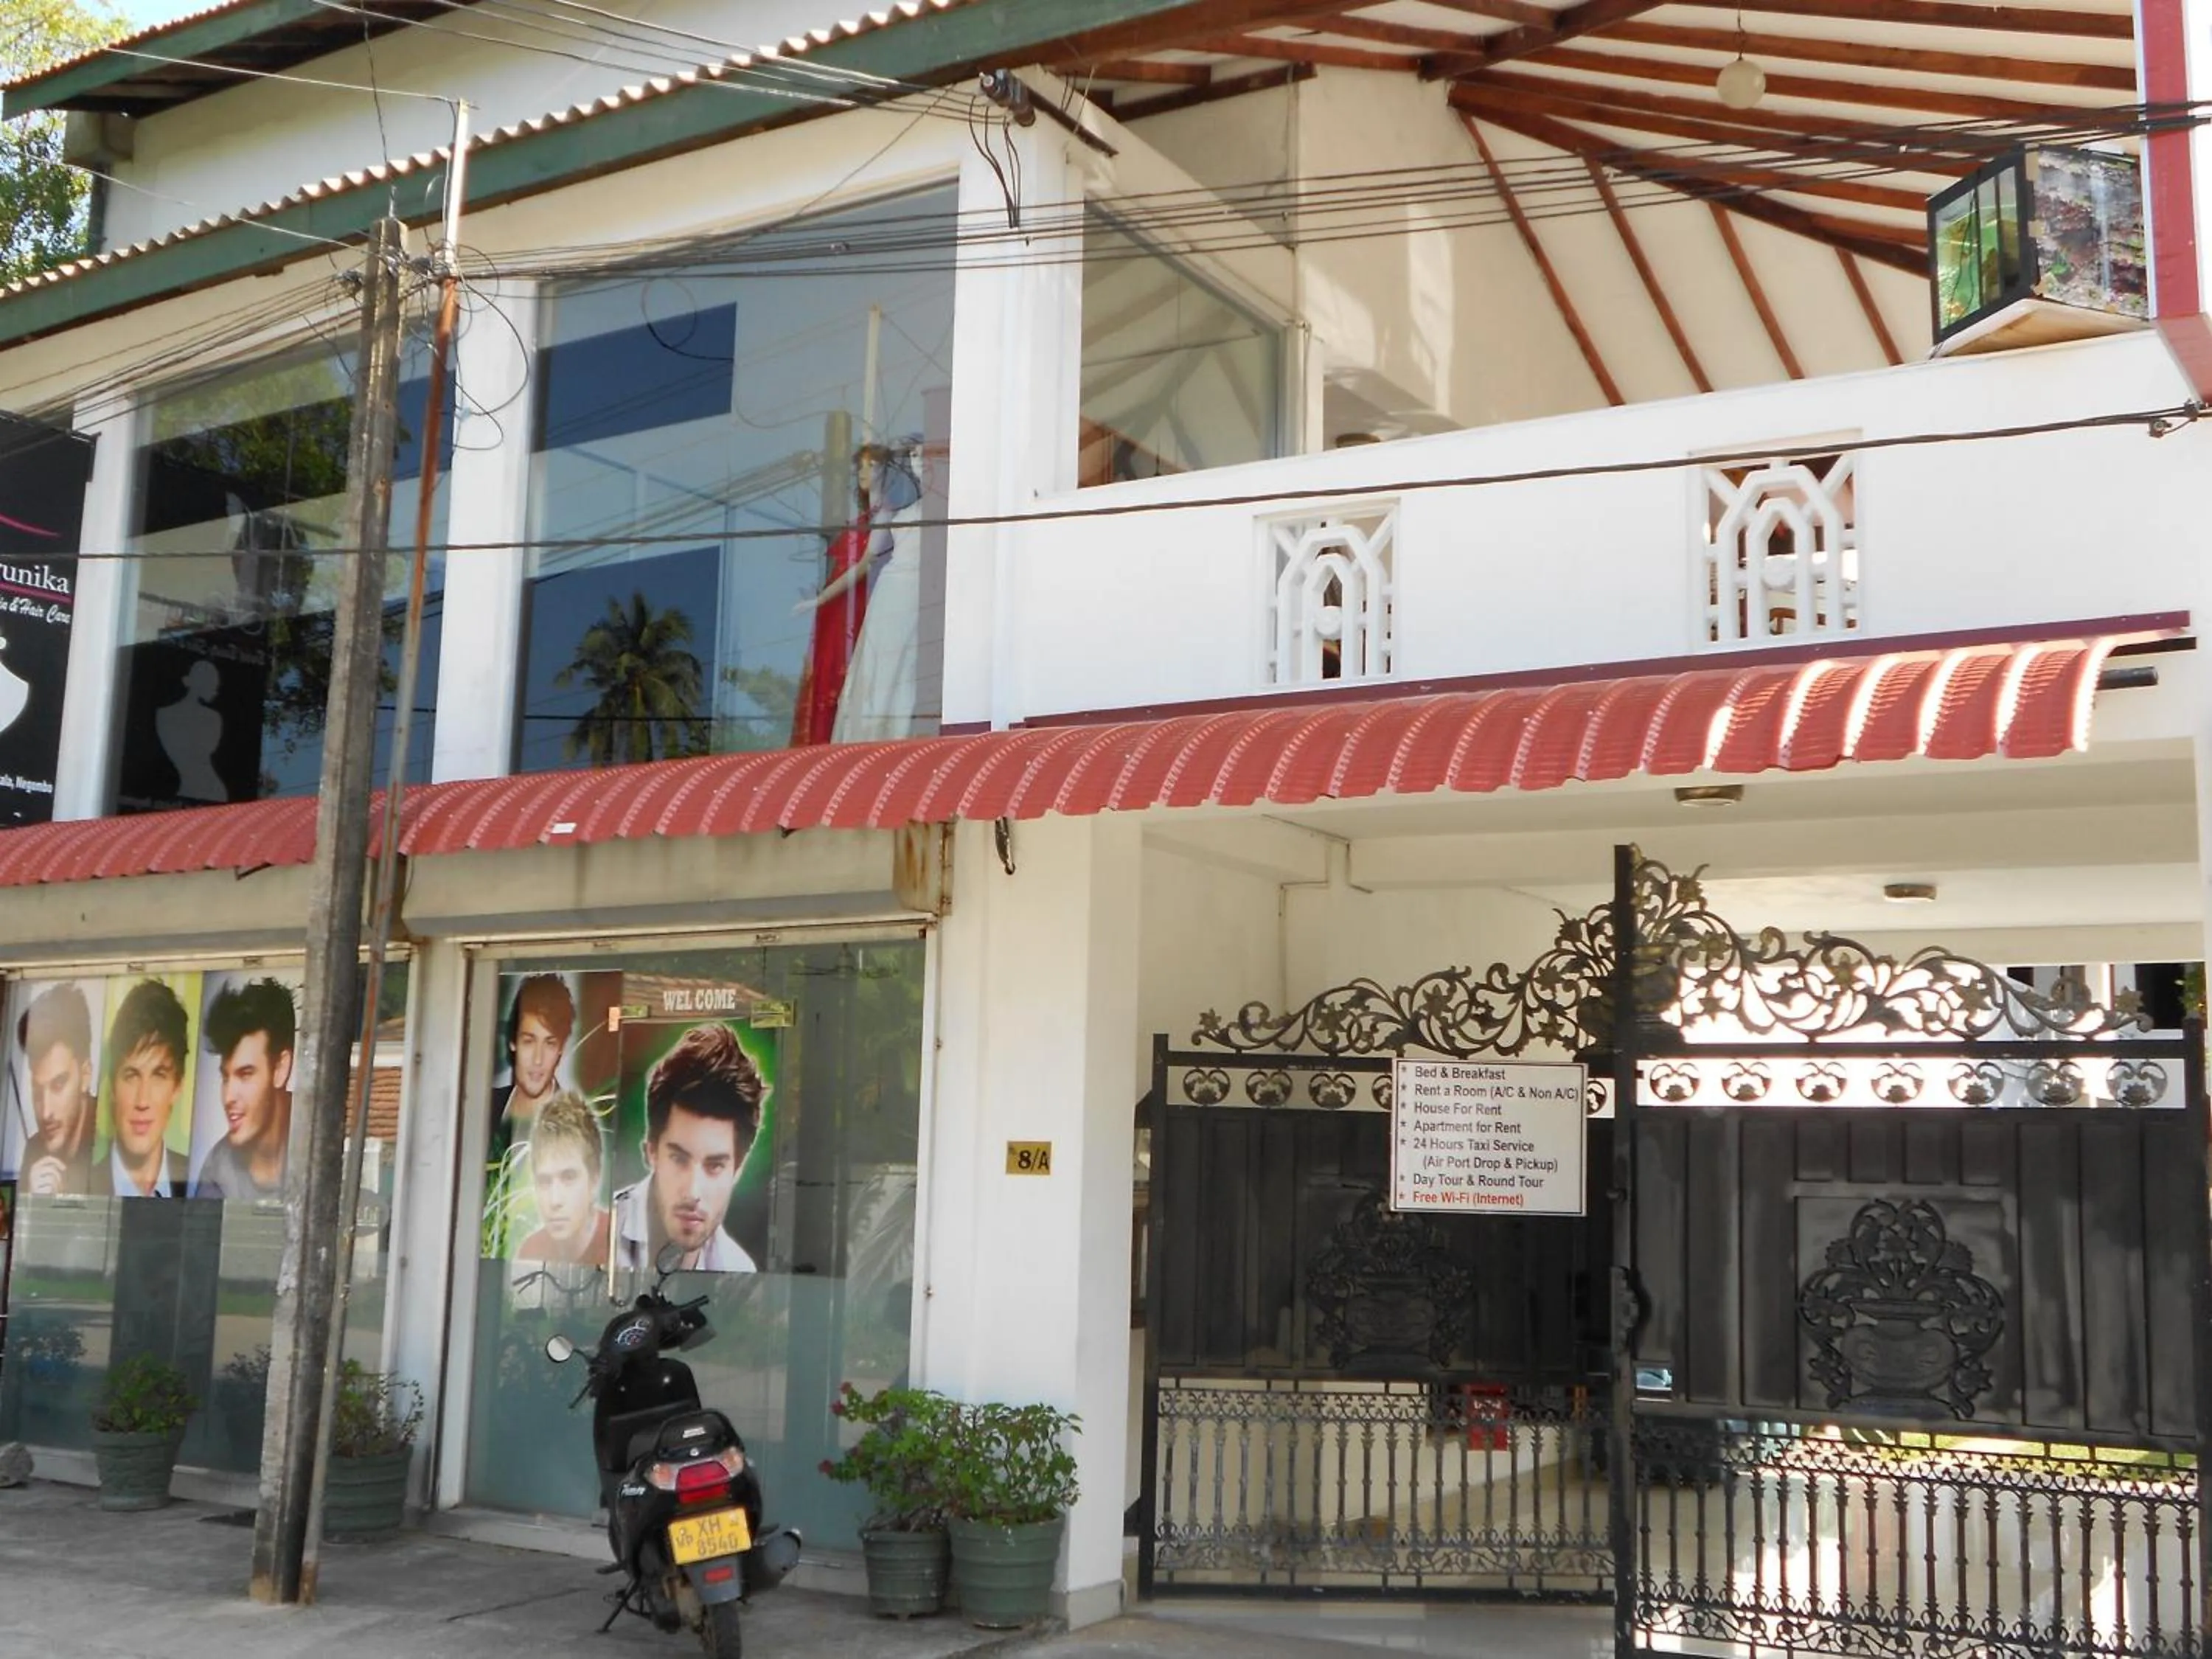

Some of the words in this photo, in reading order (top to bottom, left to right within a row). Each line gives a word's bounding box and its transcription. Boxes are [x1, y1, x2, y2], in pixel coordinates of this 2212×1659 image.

[46, 604, 72, 624] Care
[1415, 1065, 1437, 1078] Bed
[1440, 1066, 1449, 1079] &
[1452, 1067, 1506, 1080] Breakfast
[1415, 1083, 1440, 1096] Rent
[1444, 1087, 1450, 1096] a
[1453, 1085, 1487, 1097] Room
[1490, 1085, 1514, 1100] (A/C
[1517, 1086, 1526, 1098] &
[1529, 1086, 1552, 1099] Non
[1555, 1088, 1579, 1102] A/C)
[1414, 1101, 1450, 1114] House
[1453, 1102, 1472, 1114] For
[1475, 1103, 1502, 1116] Rent
[1414, 1120, 1472, 1135] Apartment
[1476, 1121, 1492, 1133] for
[1495, 1121, 1521, 1134] Rent
[1413, 1137, 1427, 1150] 24
[1430, 1138, 1464, 1150] Hours
[1467, 1138, 1489, 1151] Taxi
[1493, 1139, 1534, 1152] Service
[1018, 1147, 1049, 1173] 8/A
[1422, 1155, 1444, 1169] (Air
[1447, 1155, 1470, 1168] Port
[1474, 1156, 1500, 1172] Drop
[1504, 1157, 1512, 1169] &
[1515, 1158, 1558, 1173] Pickup)
[1413, 1173, 1435, 1188] Day
[1438, 1173, 1463, 1186] Tour
[1467, 1174, 1475, 1186] &
[1478, 1175, 1515, 1187] Round
[1519, 1175, 1545, 1188] Tour
[1413, 1191, 1437, 1203] Free
[1440, 1191, 1470, 1203] Wi-Fi
[1473, 1192, 1524, 1208] (Internet)
[695, 1515, 721, 1537] XH
